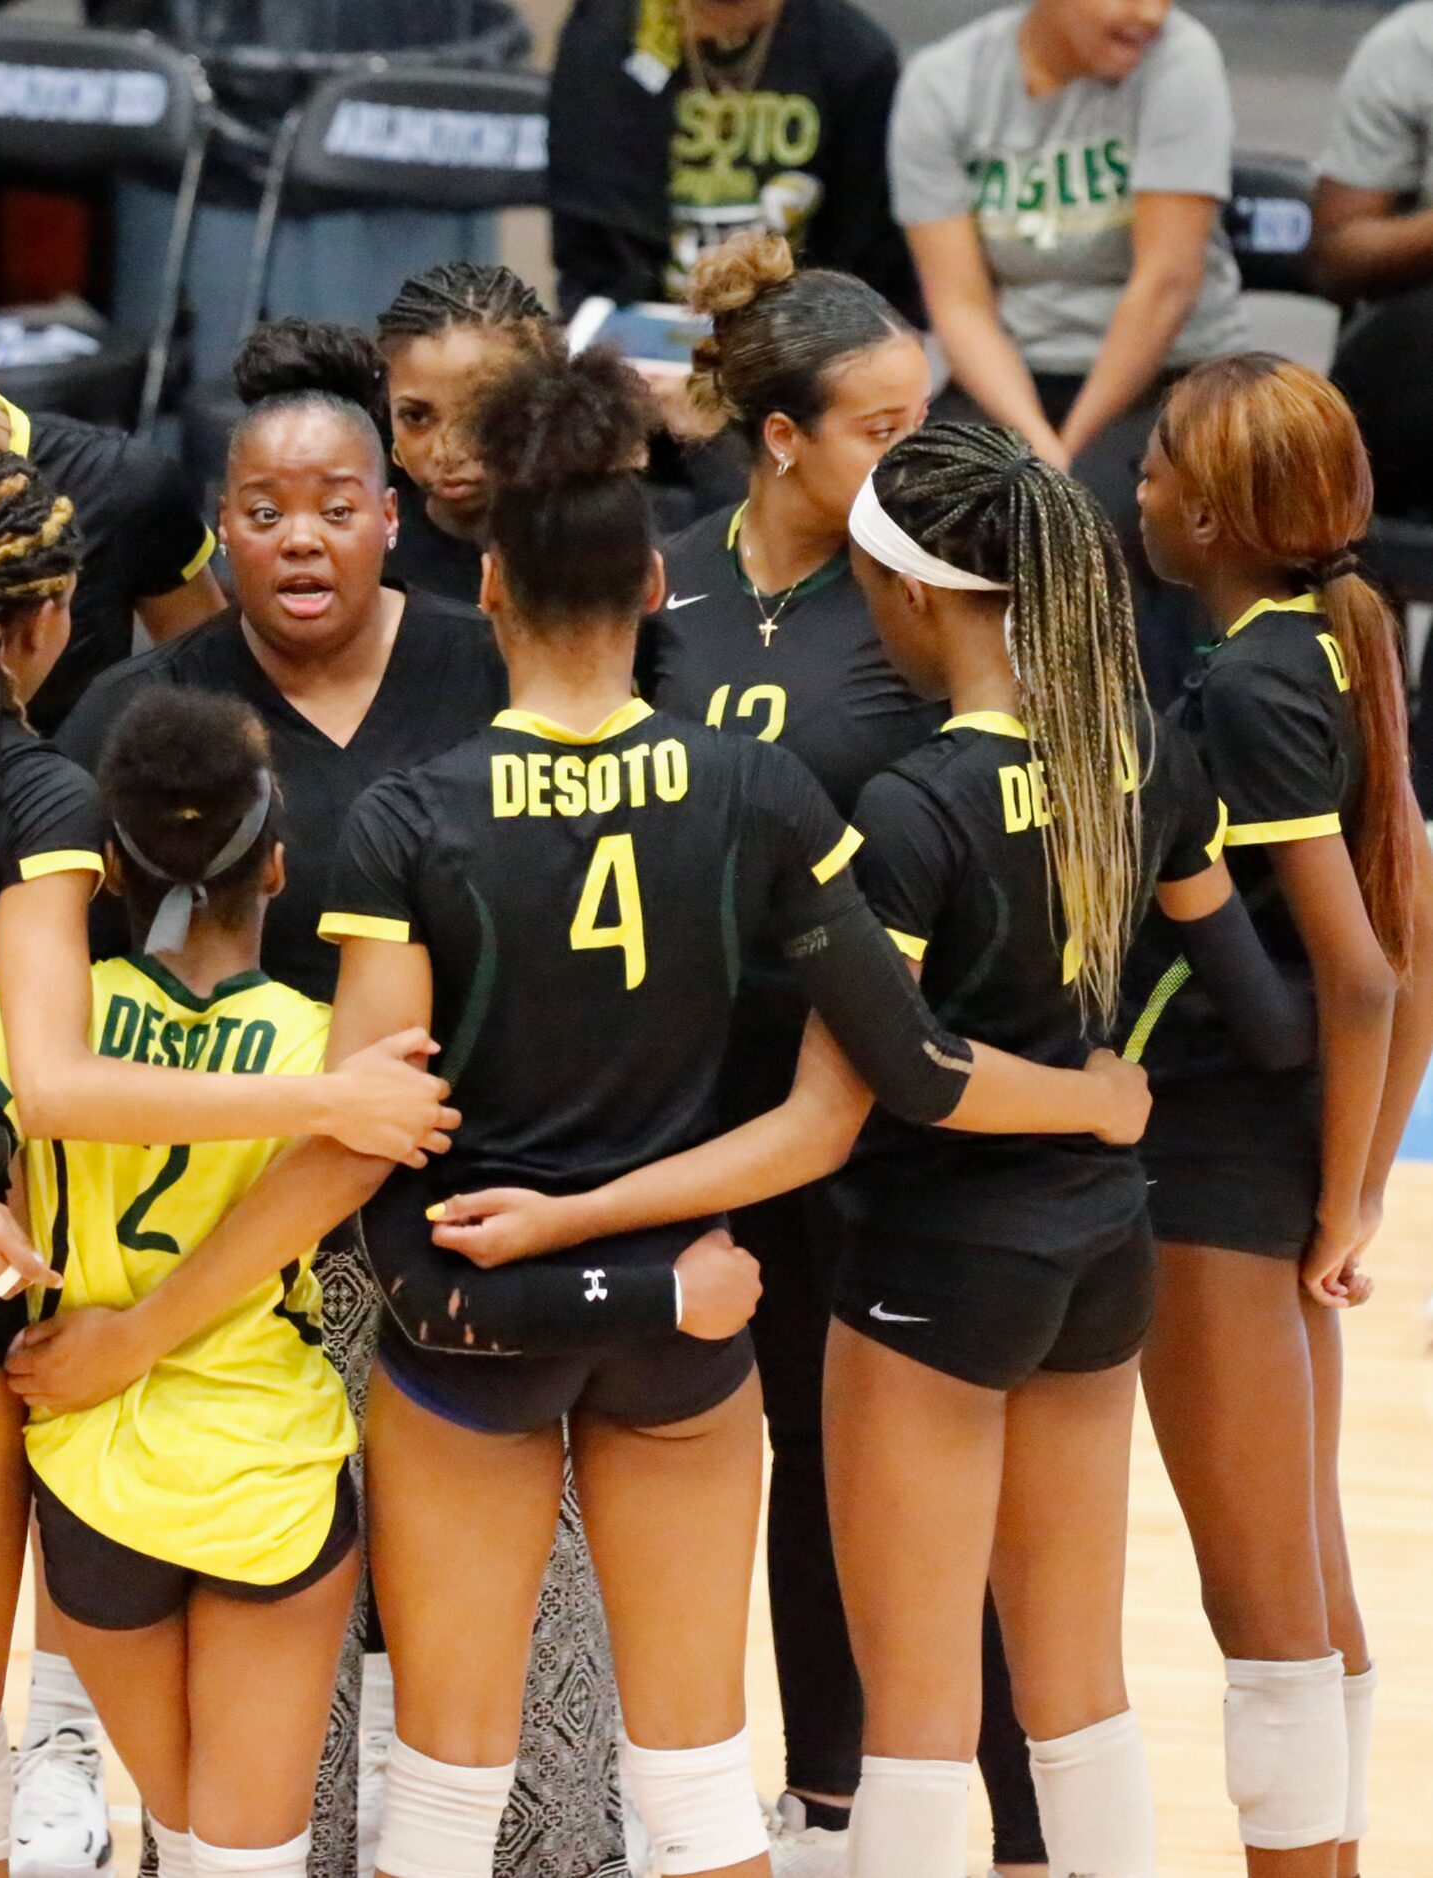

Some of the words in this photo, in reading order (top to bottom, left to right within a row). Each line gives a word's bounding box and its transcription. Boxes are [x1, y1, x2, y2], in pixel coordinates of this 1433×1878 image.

[671, 87, 821, 167] SOTO
[965, 138, 1130, 212] AGLES
[491, 738, 688, 819] DESOTO
[569, 833, 647, 991] 4
[98, 993, 277, 1075] DESOTO
